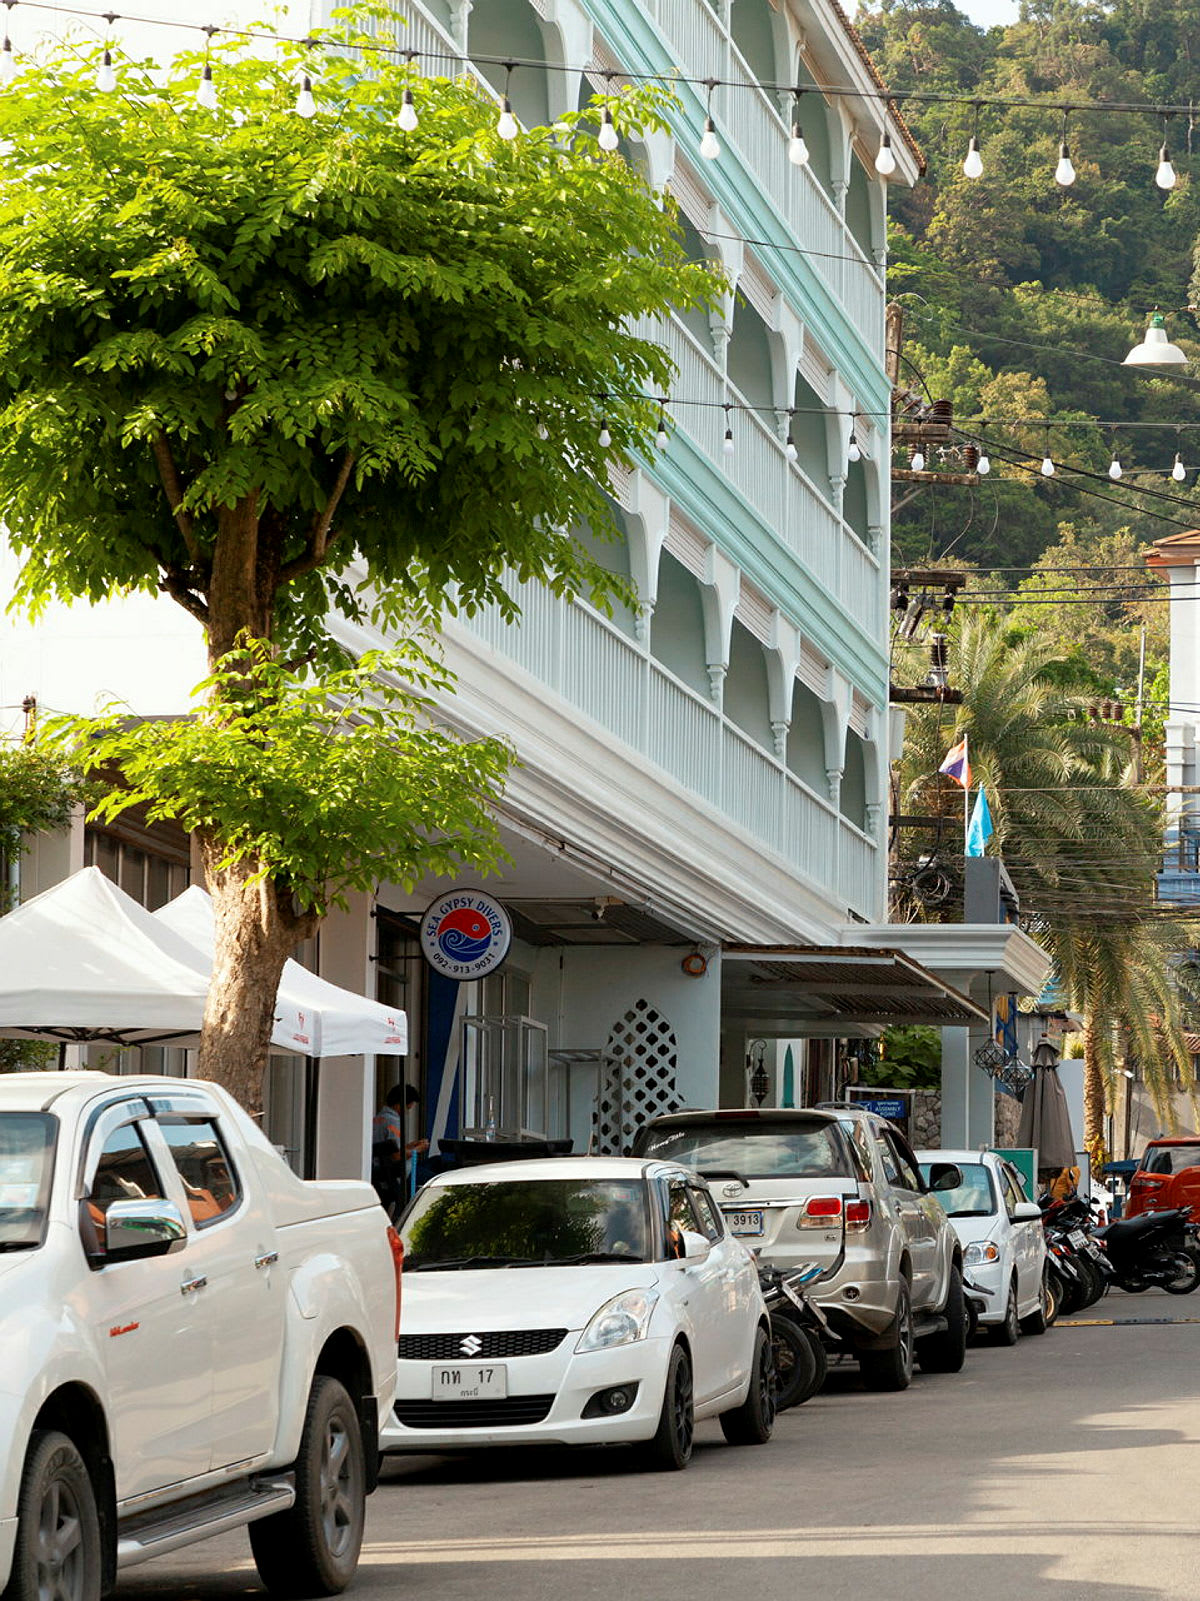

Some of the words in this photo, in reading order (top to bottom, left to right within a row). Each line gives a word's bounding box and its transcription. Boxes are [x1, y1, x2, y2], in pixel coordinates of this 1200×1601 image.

[426, 915, 442, 938] SEA
[439, 897, 474, 915] GYPSY
[475, 901, 503, 937] DIVERS
[733, 1214, 759, 1226] 3913
[441, 1370, 461, 1385] กท
[478, 1369, 493, 1383] 17
